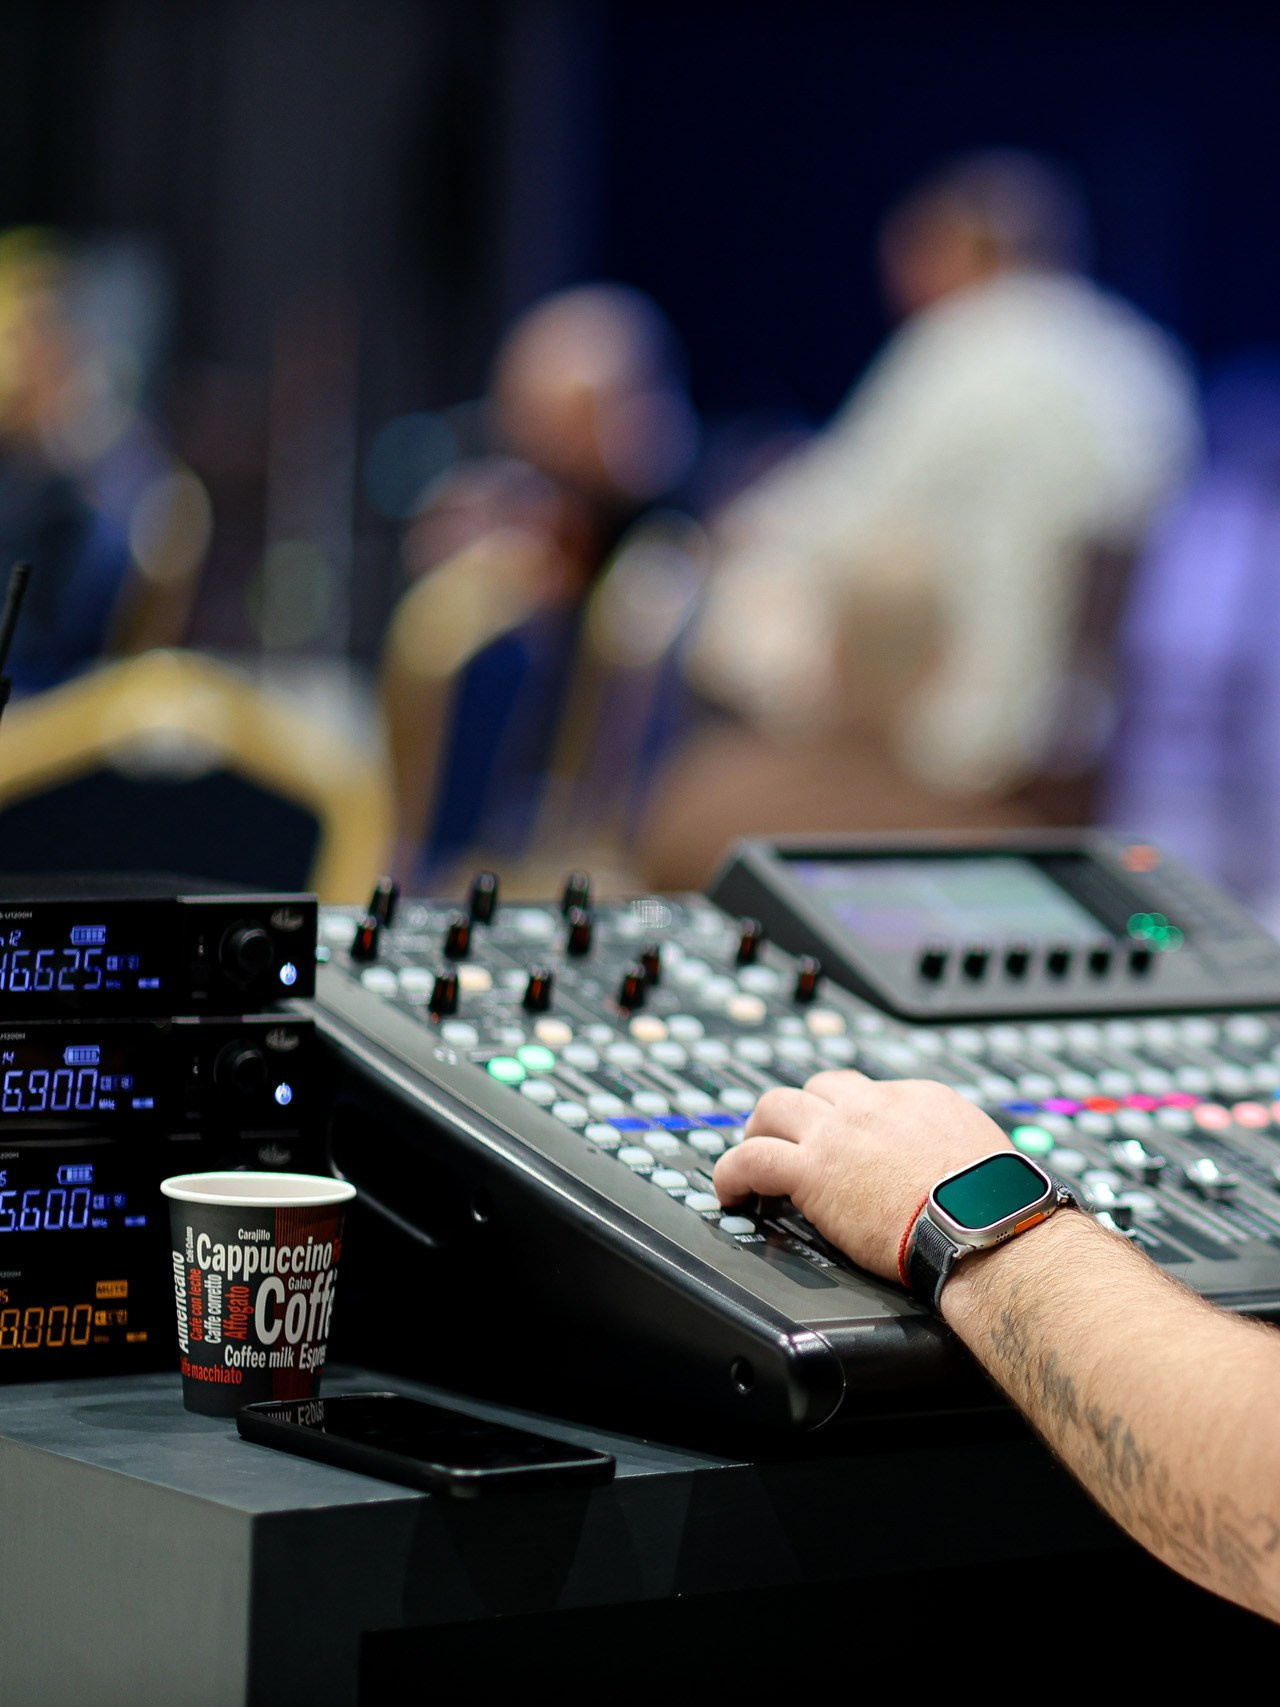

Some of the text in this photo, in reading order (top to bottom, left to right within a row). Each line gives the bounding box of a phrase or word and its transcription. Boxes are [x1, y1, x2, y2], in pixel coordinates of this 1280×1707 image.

[238, 1228, 271, 1242] Carajillo
[197, 1233, 333, 1281] Cappuccino
[172, 1250, 190, 1354] Americano
[223, 1285, 255, 1340] Affogato
[191, 1364, 243, 1384] macchiato
[225, 1345, 266, 1368] Coffee
[269, 1346, 294, 1368] milk
